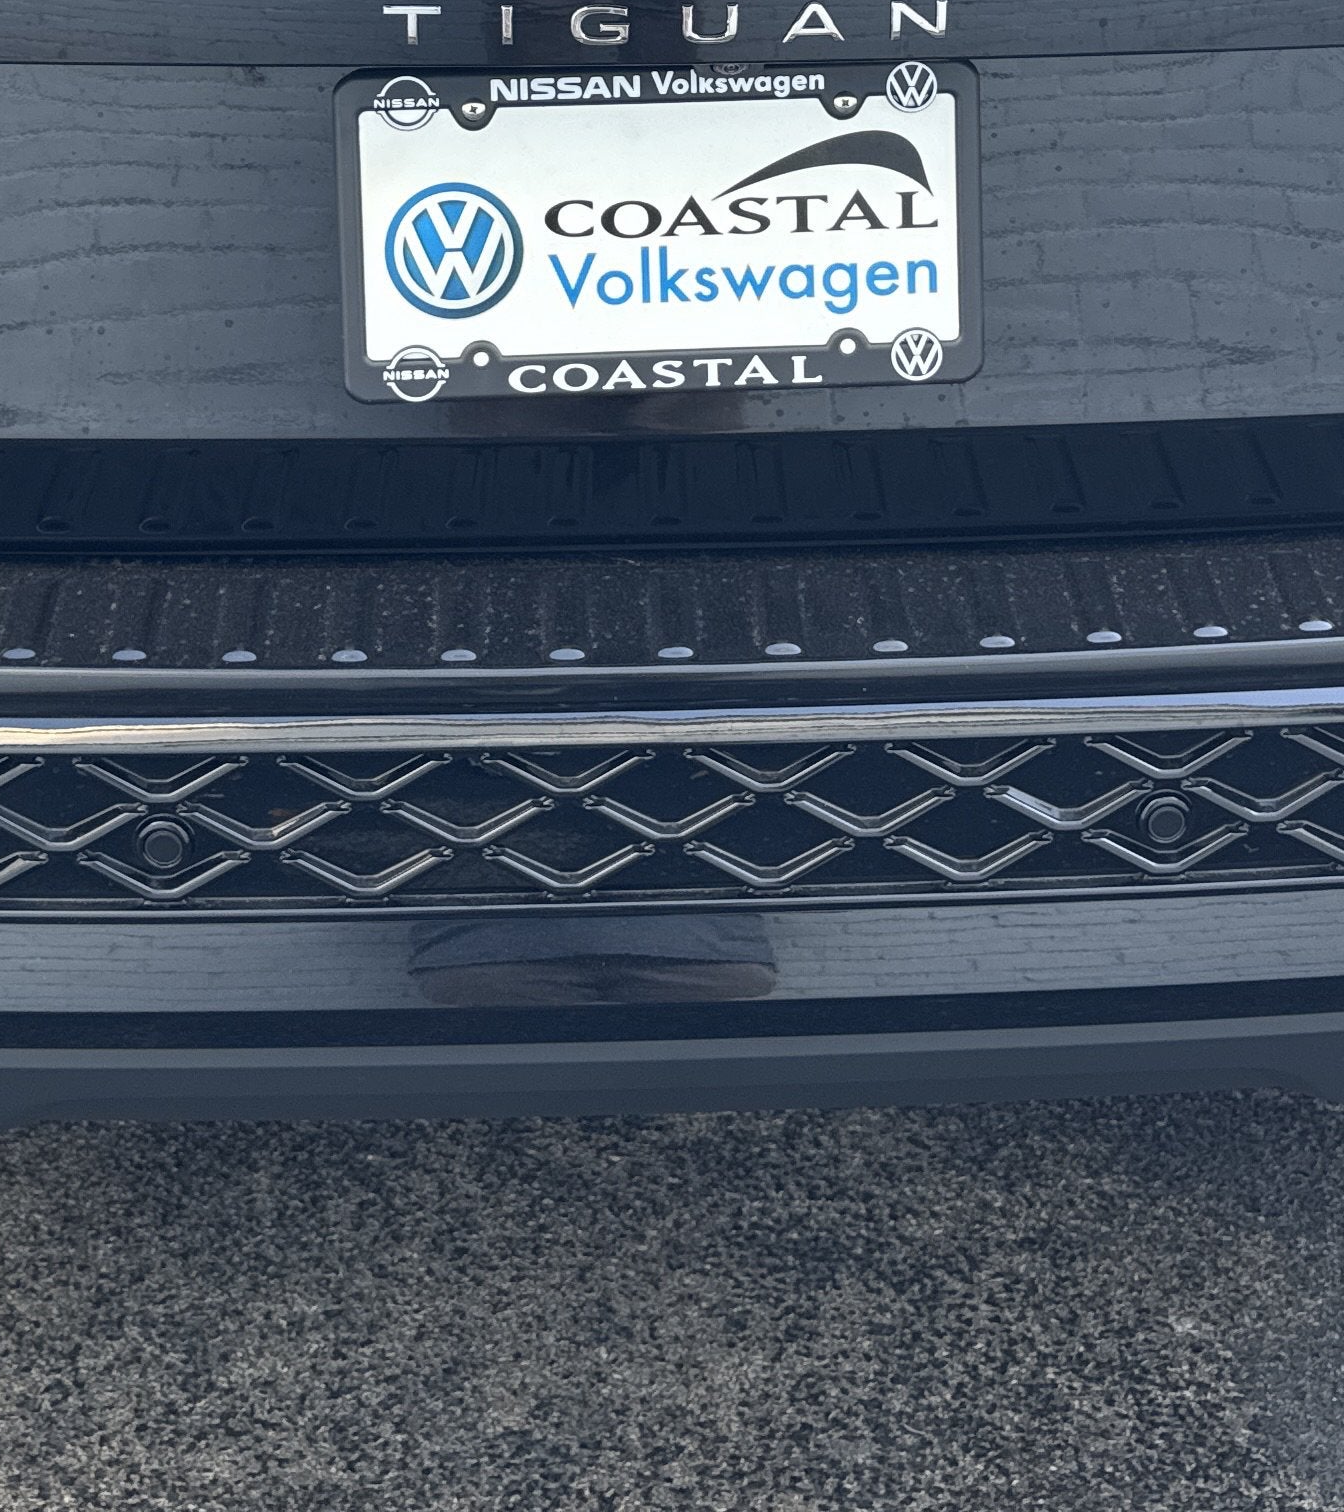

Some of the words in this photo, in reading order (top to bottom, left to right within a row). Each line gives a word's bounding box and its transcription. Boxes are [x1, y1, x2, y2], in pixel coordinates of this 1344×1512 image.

[381, 0, 949, 47] TIGUAN
[373, 94, 440, 112] NISSAN
[490, 73, 641, 103] NISSAN
[651, 69, 825, 99] Volkswagen
[544, 189, 939, 240] COASTAL
[547, 245, 939, 315] Volkswagen
[382, 368, 450, 382] NISSAN
[507, 354, 824, 394] COASTAL
